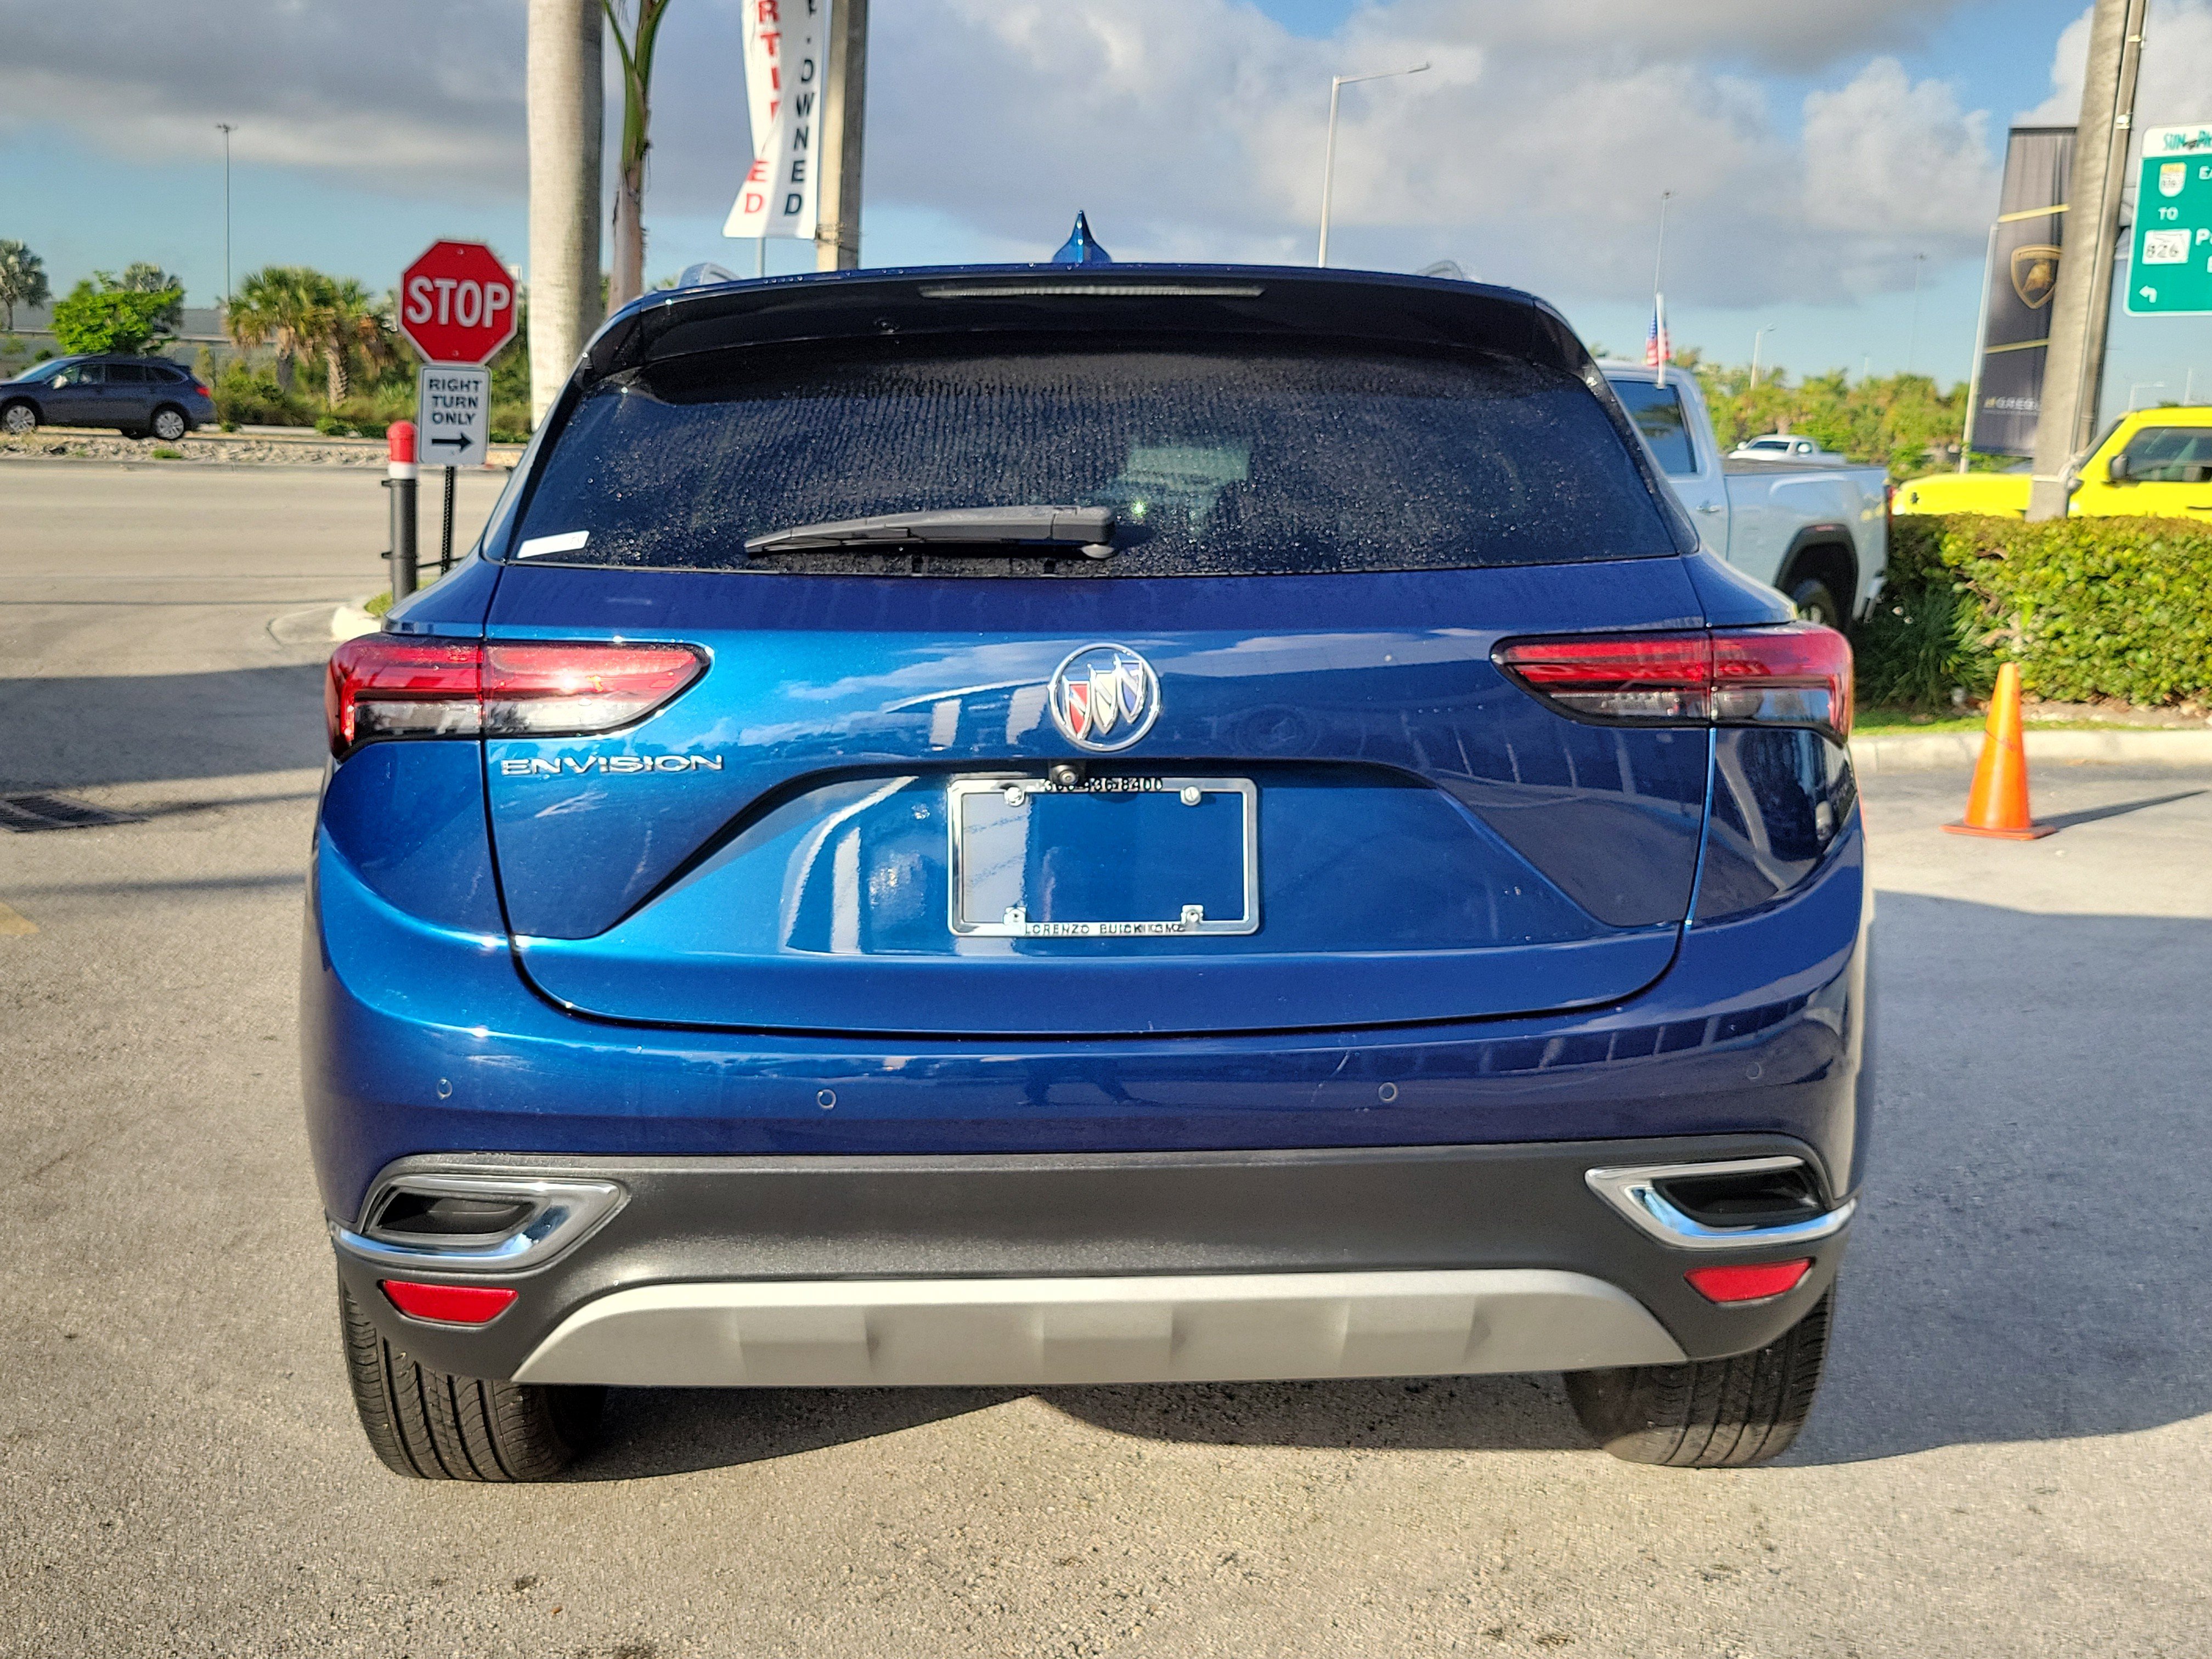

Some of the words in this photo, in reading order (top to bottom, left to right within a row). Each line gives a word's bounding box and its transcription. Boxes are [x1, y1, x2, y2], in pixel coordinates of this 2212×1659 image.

[2158, 206, 2179, 221] TO
[2146, 242, 2180, 258] 826
[405, 275, 511, 328] STOP
[428, 379, 482, 392] RIGHT
[432, 395, 479, 408] TURN
[432, 411, 476, 425] ONLY
[500, 754, 724, 776] ENVISION
[1025, 923, 1090, 935] LORENZO
[1099, 923, 1143, 934] BUICK
